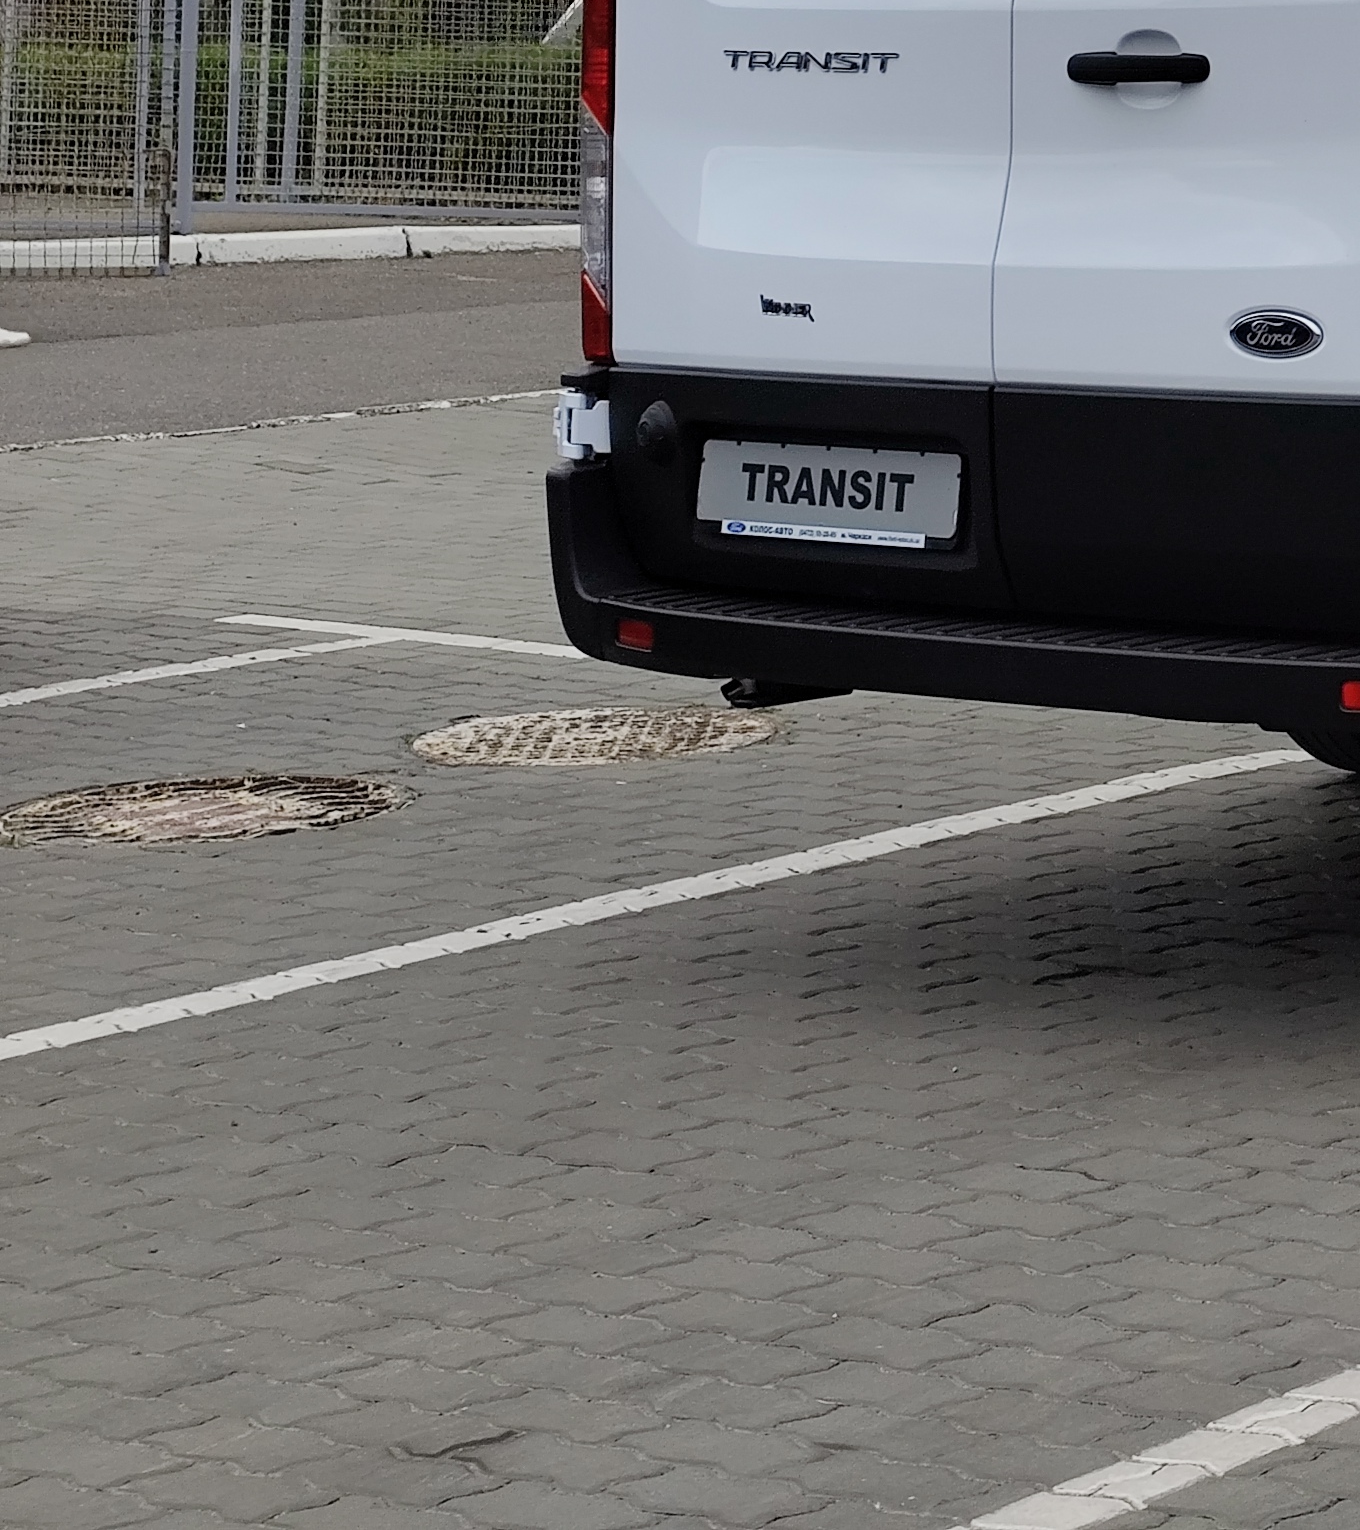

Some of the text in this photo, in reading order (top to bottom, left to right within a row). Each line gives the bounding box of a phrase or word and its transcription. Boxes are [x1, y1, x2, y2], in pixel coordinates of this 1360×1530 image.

[724, 50, 900, 73] TRANSIT
[1246, 320, 1298, 346] Ford
[742, 463, 915, 512] TRANSIT
